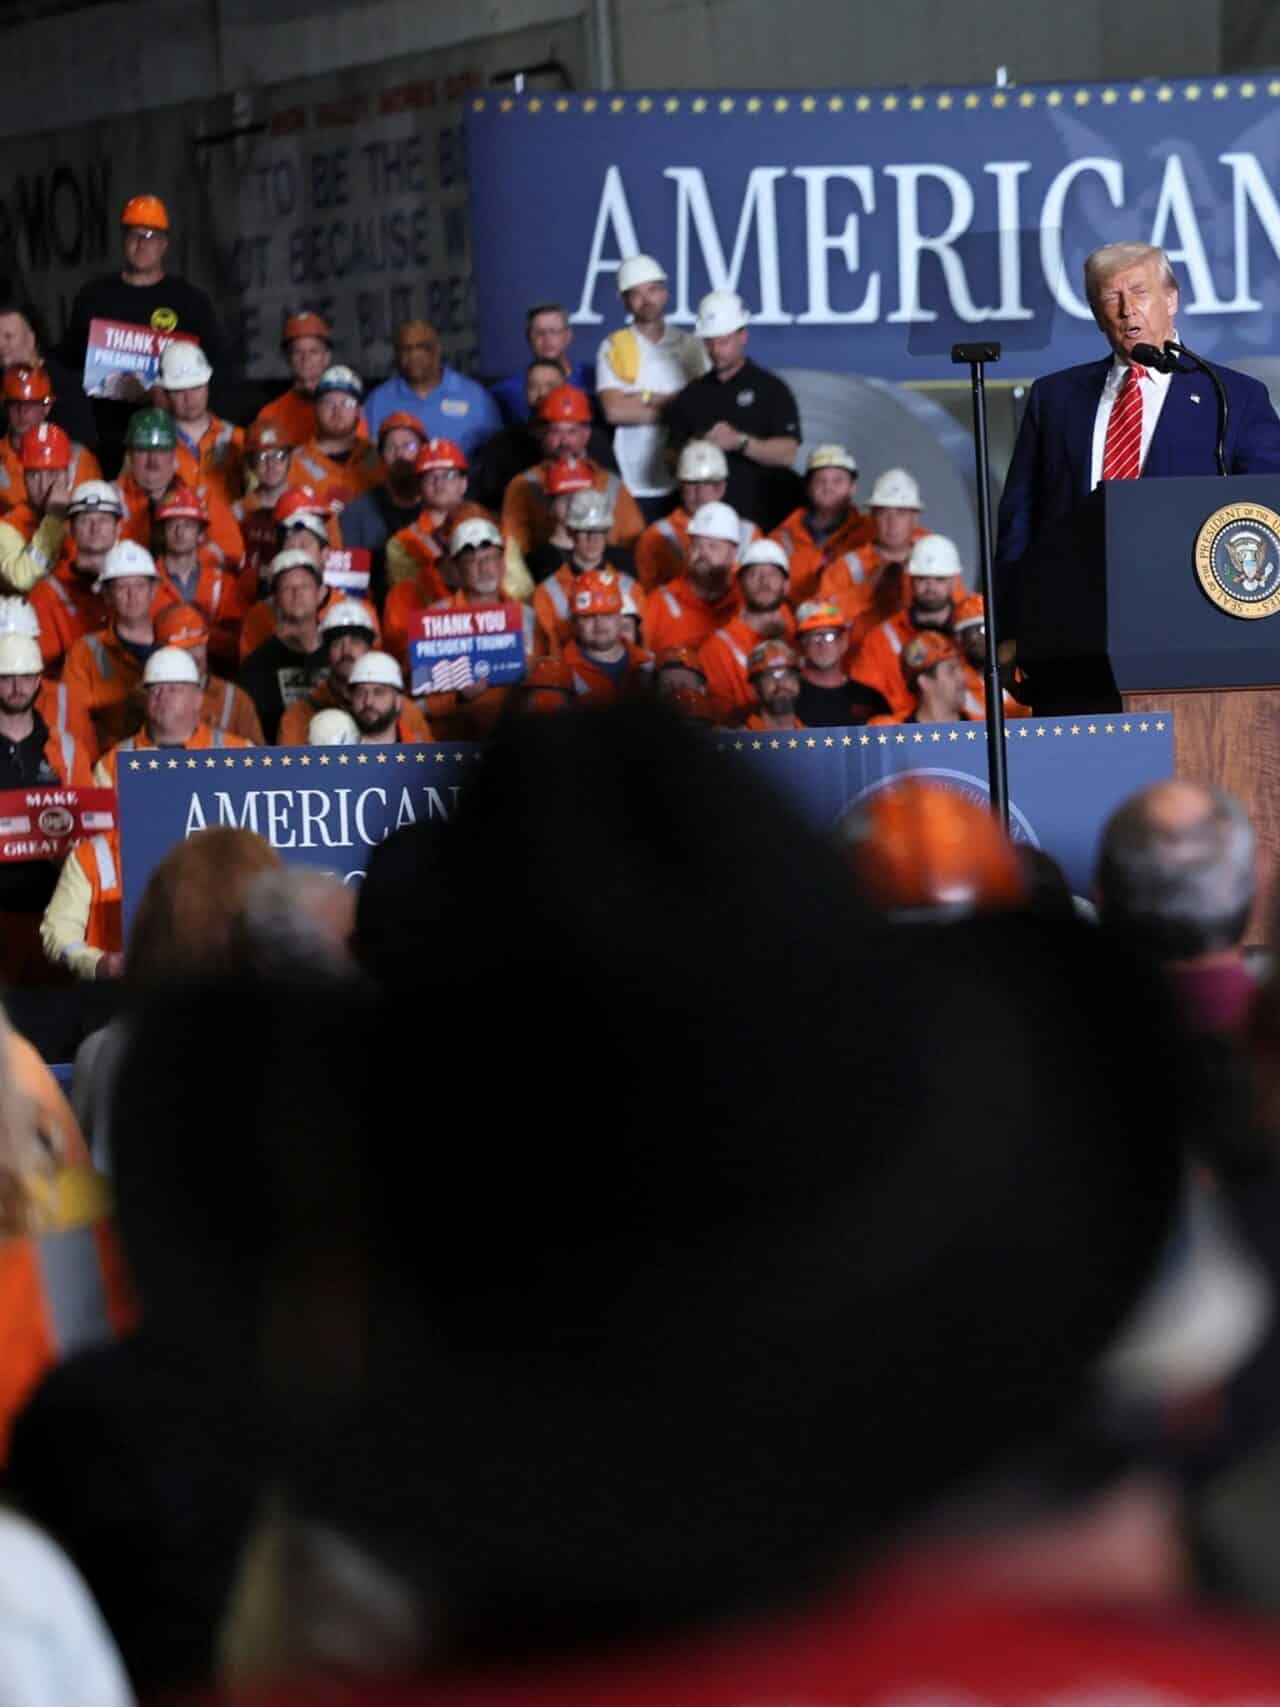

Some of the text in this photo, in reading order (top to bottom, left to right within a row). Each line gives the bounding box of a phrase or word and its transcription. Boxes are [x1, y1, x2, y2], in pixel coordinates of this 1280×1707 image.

[105, 327, 155, 354] THANK
[1199, 507, 1241, 559] PRESIDENT
[422, 610, 506, 639] THANK YOU
[416, 636, 473, 658] PRESIDENT
[26, 791, 79, 807] MAKE
[185, 782, 463, 848] AMERICAN
[3, 840, 57, 857] GREAT
